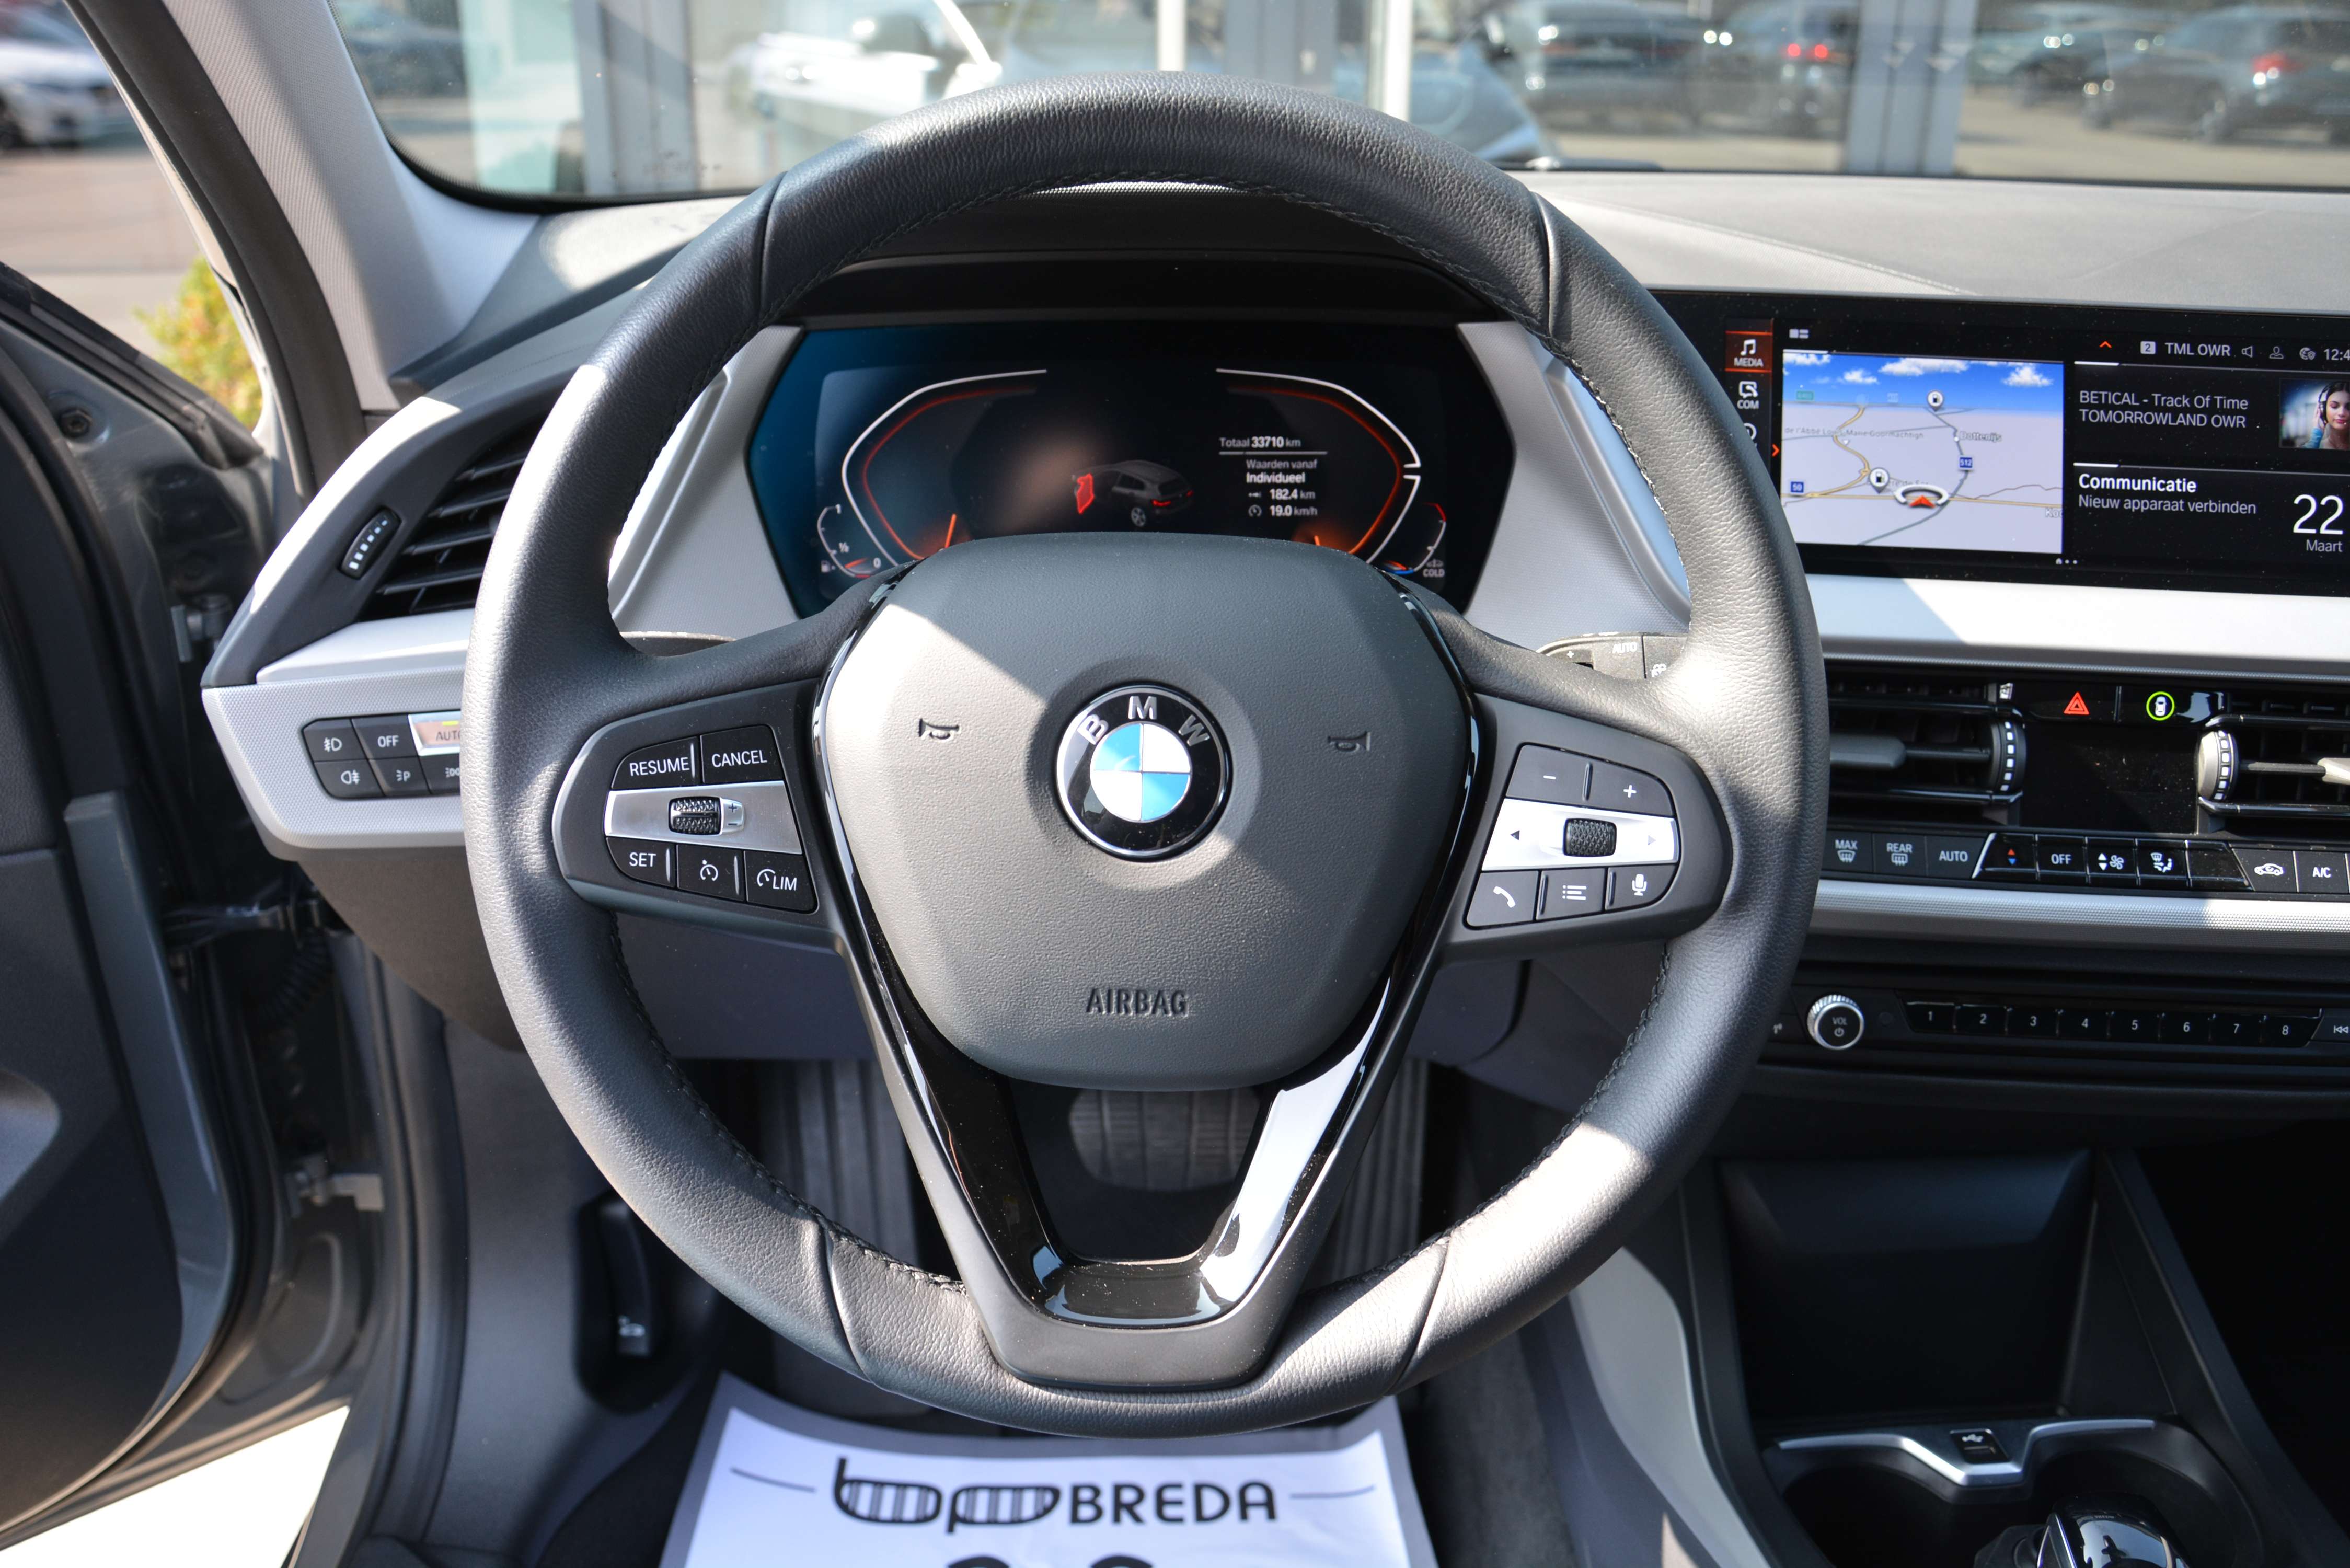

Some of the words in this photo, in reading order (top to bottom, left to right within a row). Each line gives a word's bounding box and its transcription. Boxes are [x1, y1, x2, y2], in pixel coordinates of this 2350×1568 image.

[2165, 342, 2195, 355] TML
[2197, 343, 2231, 357] OWR
[1734, 356, 1764, 367] MEDIA
[1737, 400, 1760, 409] COM
[2079, 391, 2139, 405] BETICAL
[2151, 393, 2190, 408] Track
[2194, 395, 2211, 409] Of
[2213, 396, 2249, 410] Time
[2079, 409, 2208, 427] TOMORROWLAND
[2211, 414, 2246, 429] OWR
[1219, 437, 1250, 448] Totaal
[1251, 436, 1284, 448] 33710
[1286, 437, 1301, 448] km
[1246, 458, 1289, 470] Waarden
[1291, 458, 1318, 470] vanaf
[1960, 458, 1973, 467] 512
[1246, 472, 1306, 484] Individueel
[2078, 474, 2197, 493] Communicatie
[1269, 489, 1299, 501] 182.4
[1300, 489, 1316, 500] km
[1269, 505, 1293, 517] 19.0
[1294, 505, 1318, 517] km/h
[2078, 494, 2121, 510] Nieuw
[2123, 499, 2184, 514] apparaat
[2188, 500, 2256, 515] verbinden
[2293, 494, 2344, 535] 22
[2306, 539, 2343, 552] Maart
[1423, 568, 1445, 578] COLD
[1612, 642, 1638, 654] AUTO
[1077, 695, 1211, 747] BMW
[377, 734, 399, 748] OFF
[435, 729, 460, 742] AUT
[629, 756, 690, 777] RESUME
[711, 749, 768, 768] CANCEL
[1835, 839, 1858, 851] MAX
[1886, 842, 1913, 854] REAR
[629, 851, 656, 868] SET
[1938, 850, 1968, 863] AUTO
[2051, 854, 2072, 866] OFF
[2312, 867, 2332, 879] A/C
[773, 876, 798, 891] LIM
[1085, 988, 1189, 1017] AIRBAG
[1832, 1016, 1847, 1026] VOL
[1928, 1011, 1933, 1022] 1
[1979, 1013, 1987, 1024] 2
[2030, 1016, 2037, 1027] 3
[2081, 1018, 2089, 1029] 4
[2131, 1020, 2138, 1031] 5
[2183, 1021, 2190, 1033] 6
[2233, 1023, 2240, 1034] 7
[2282, 1024, 2289, 1036] 8
[1069, 1480, 1277, 1525] BREDA
